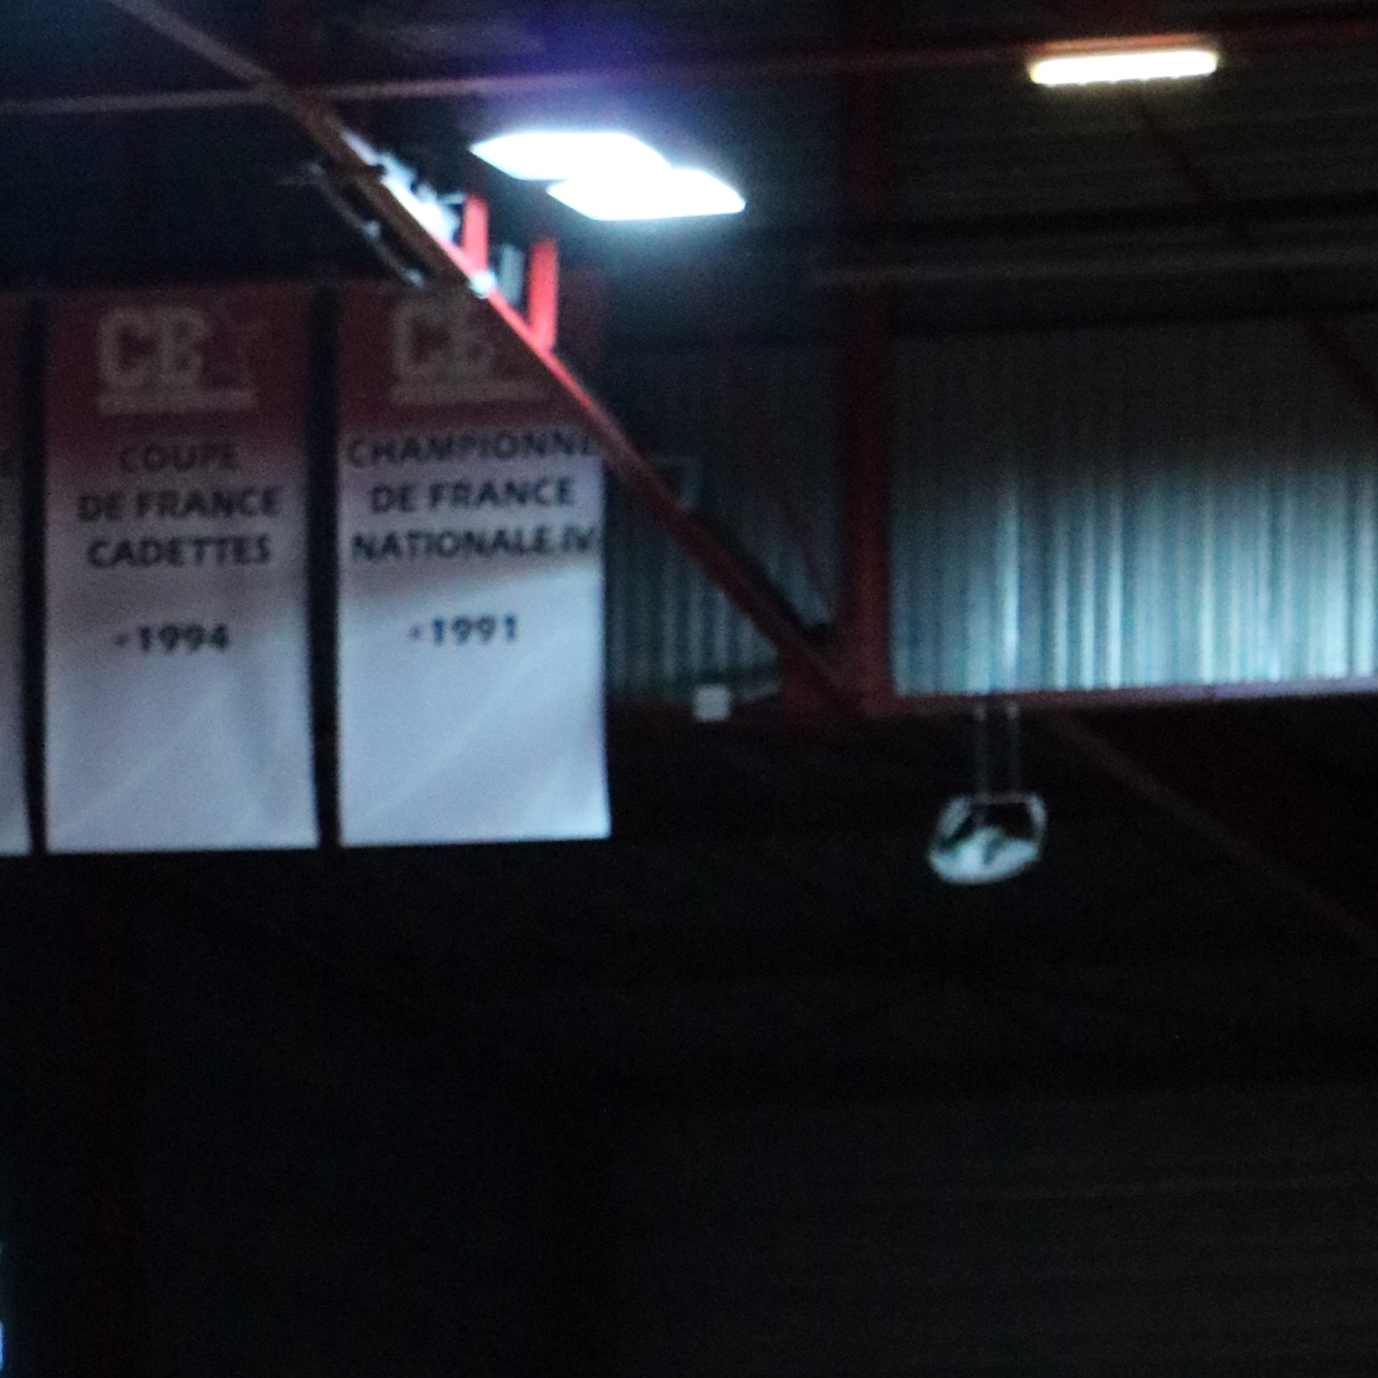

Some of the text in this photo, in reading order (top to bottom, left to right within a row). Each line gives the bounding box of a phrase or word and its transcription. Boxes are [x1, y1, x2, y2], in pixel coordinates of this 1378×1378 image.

[118, 441, 239, 474] COUPE
[76, 485, 283, 523] DE FRANCE
[370, 476, 574, 514] DE FRANCE
[86, 533, 272, 570] CADETTES
[136, 623, 230, 654] 1994
[430, 616, 518, 645] 1991
